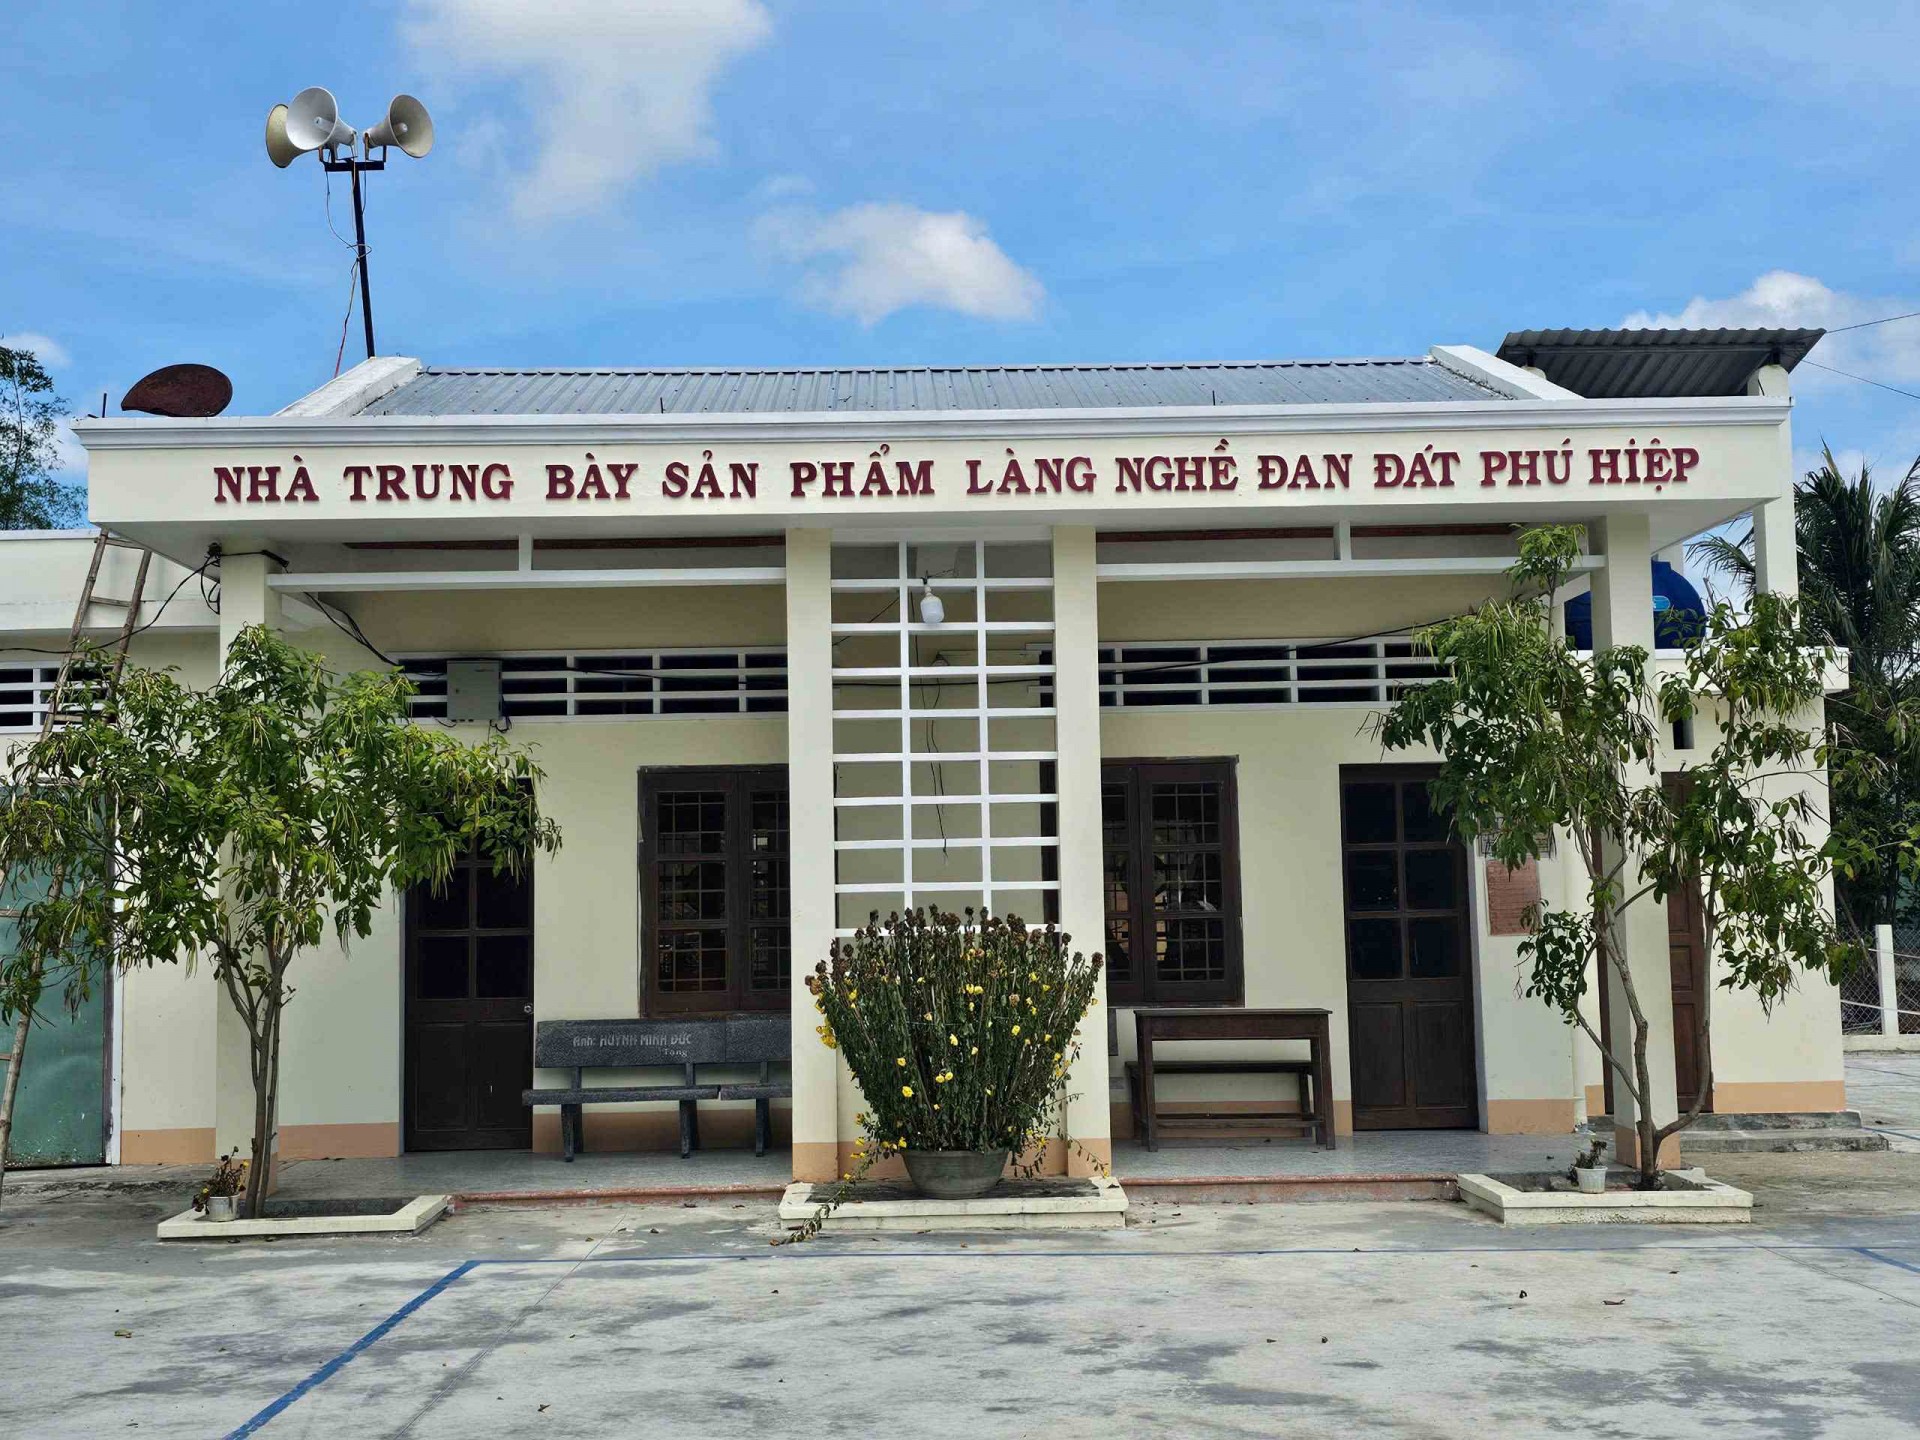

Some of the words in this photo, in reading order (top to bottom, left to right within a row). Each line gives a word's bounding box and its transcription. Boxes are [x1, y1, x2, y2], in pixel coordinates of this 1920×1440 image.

[214, 455, 319, 503] NHÀ
[344, 463, 514, 501] TRƯNG
[546, 452, 638, 500] BÀY
[662, 450, 758, 499] SẢN
[790, 444, 935, 497] PHẨM
[966, 448, 1097, 494] LÀNG
[1115, 438, 1239, 492] NGHỀ
[1257, 454, 1353, 490] ĐAN
[1374, 444, 1461, 488] ĐÁT
[1480, 438, 1573, 486] PHÚ
[1588, 438, 1700, 492] HIỆP
[640, 1034, 667, 1046] MINH
